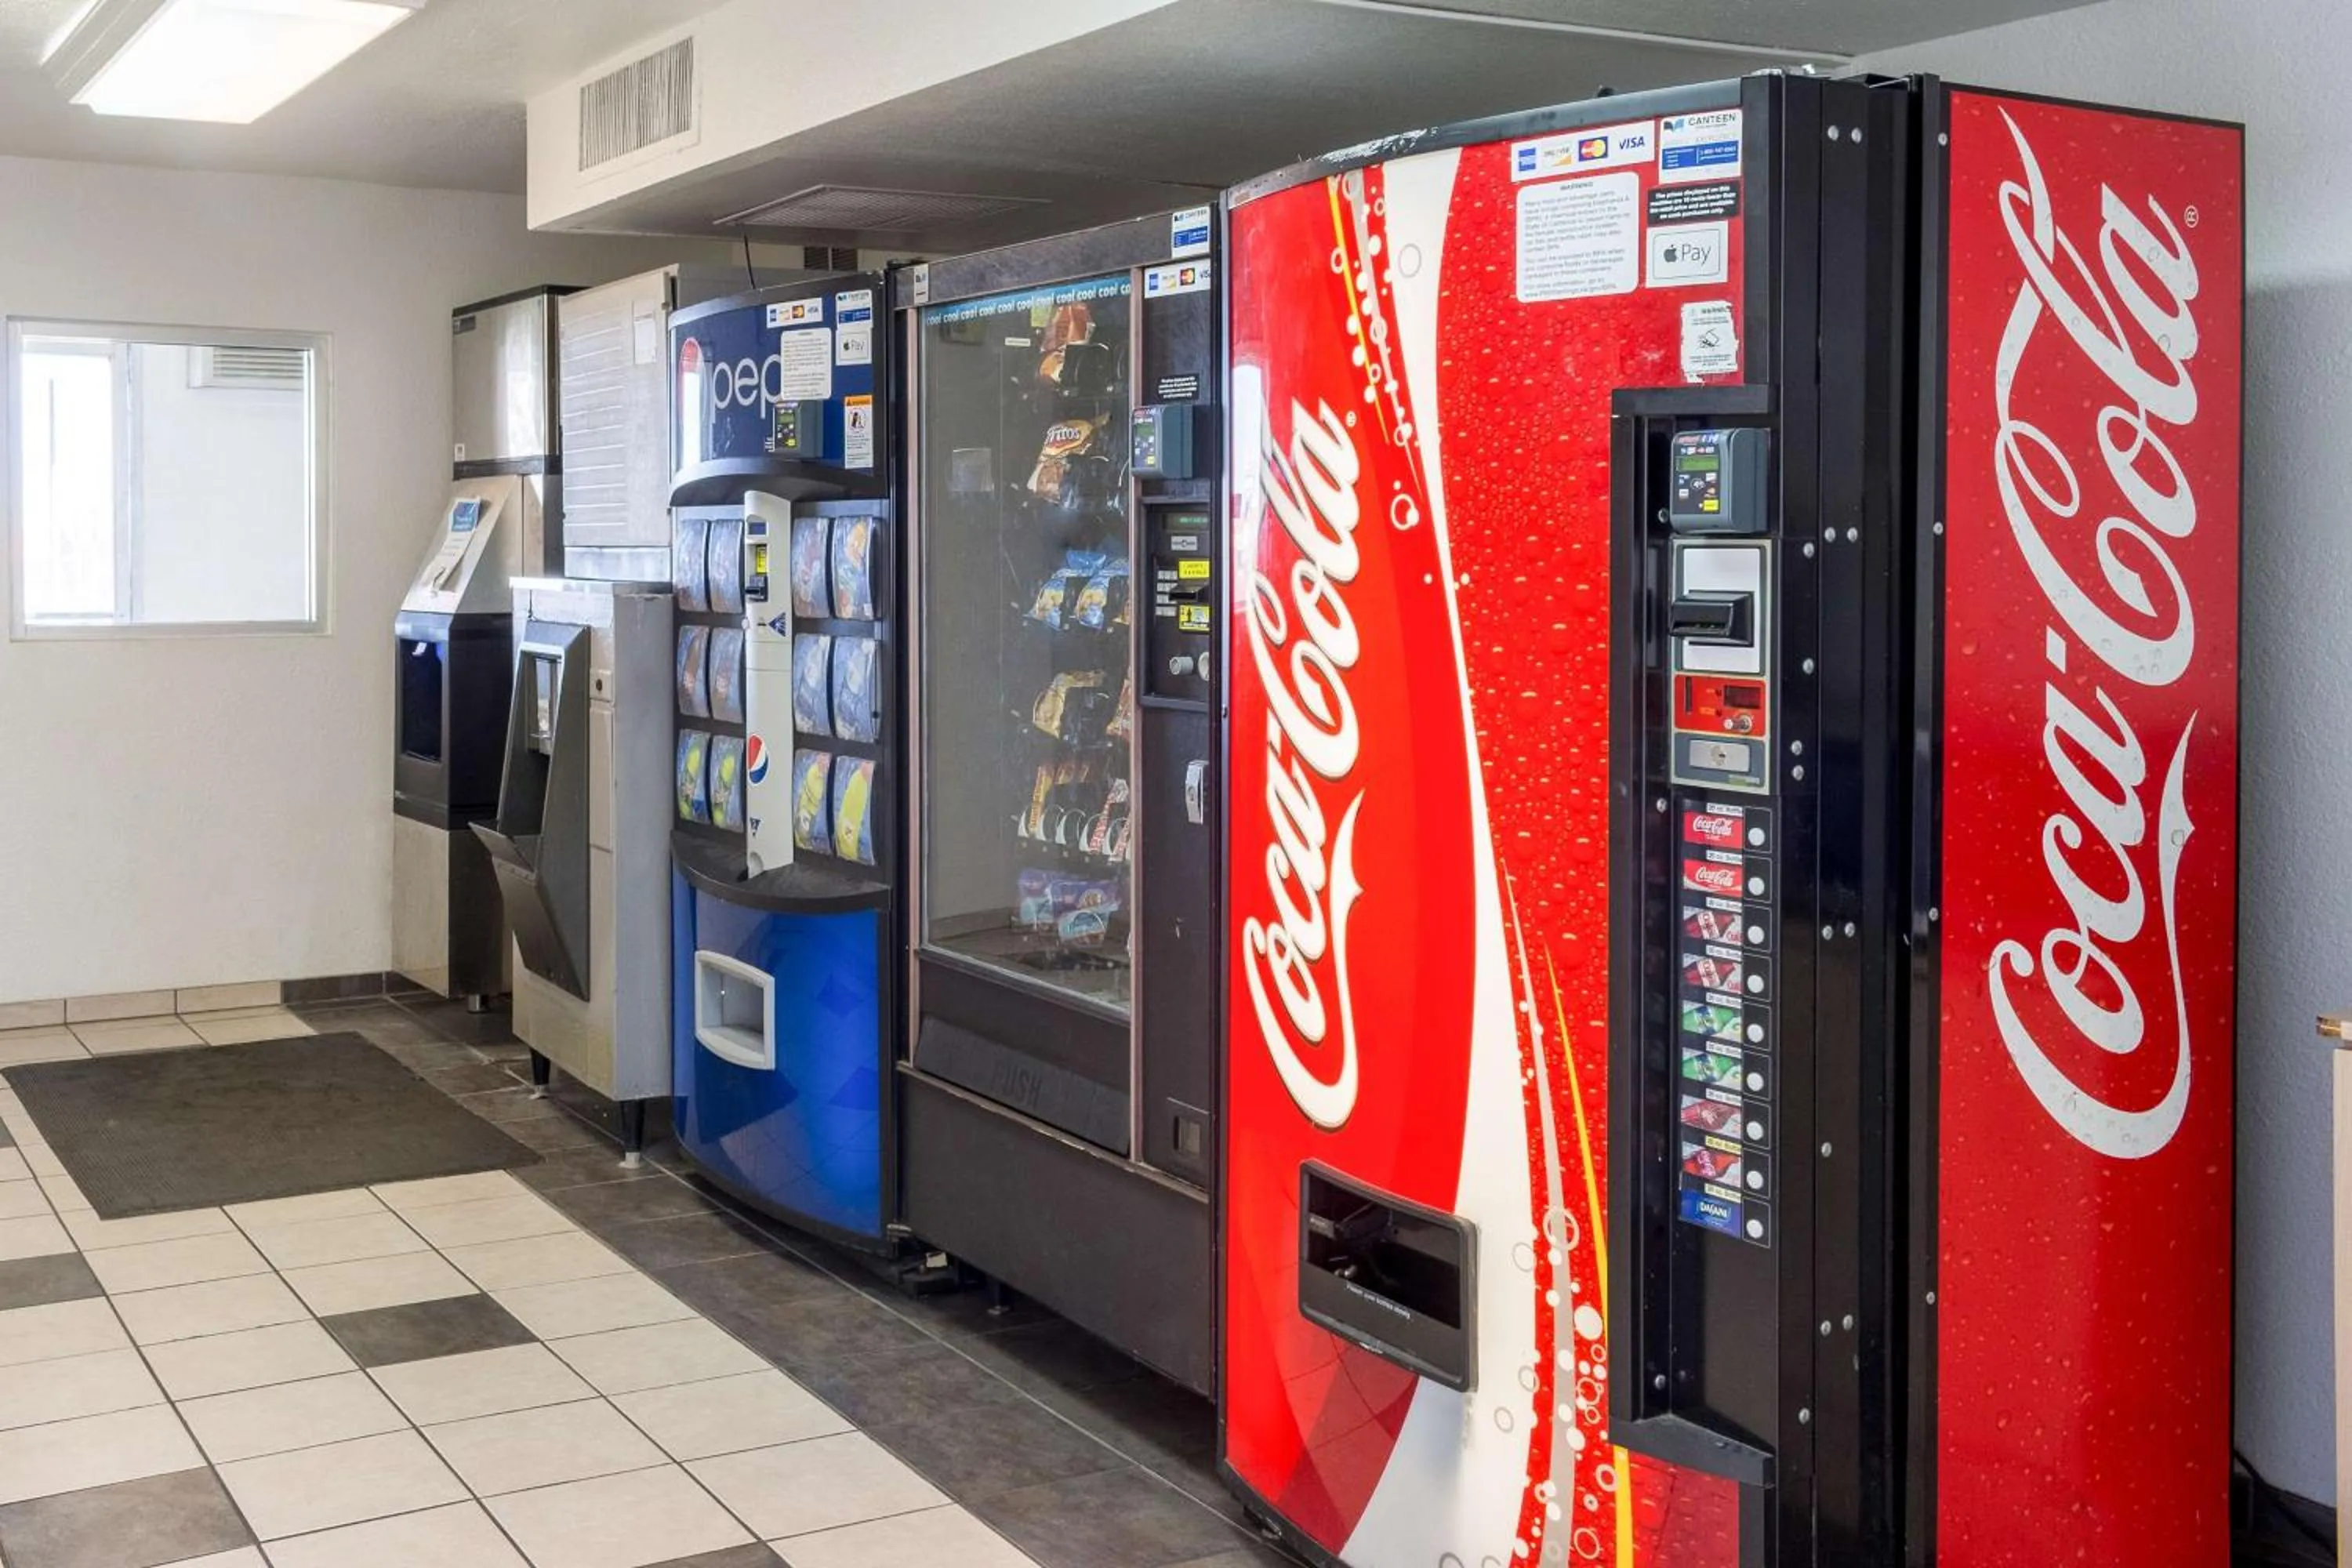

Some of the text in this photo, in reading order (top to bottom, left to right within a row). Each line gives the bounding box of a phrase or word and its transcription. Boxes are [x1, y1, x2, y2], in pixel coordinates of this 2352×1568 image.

[1688, 113, 1737, 126] CANTEEN
[1619, 136, 1645, 150] VISA
[1682, 244, 1711, 267] Pay
[943, 310, 959, 322] cool
[961, 307, 978, 320] cool
[979, 304, 996, 317] cool
[997, 301, 1014, 313] cool
[1017, 296, 1033, 311] cool
[1057, 290, 1075, 304] cool
[1077, 287, 1096, 301] cool
[1099, 283, 1118, 297] cool
[1120, 284, 1131, 296] co
[713, 354, 782, 424] pep
[1989, 104, 2198, 1160] Coca-Cola
[1244, 392, 1365, 1128] Coca-Cola
[993, 1062, 1044, 1107] PUSH
